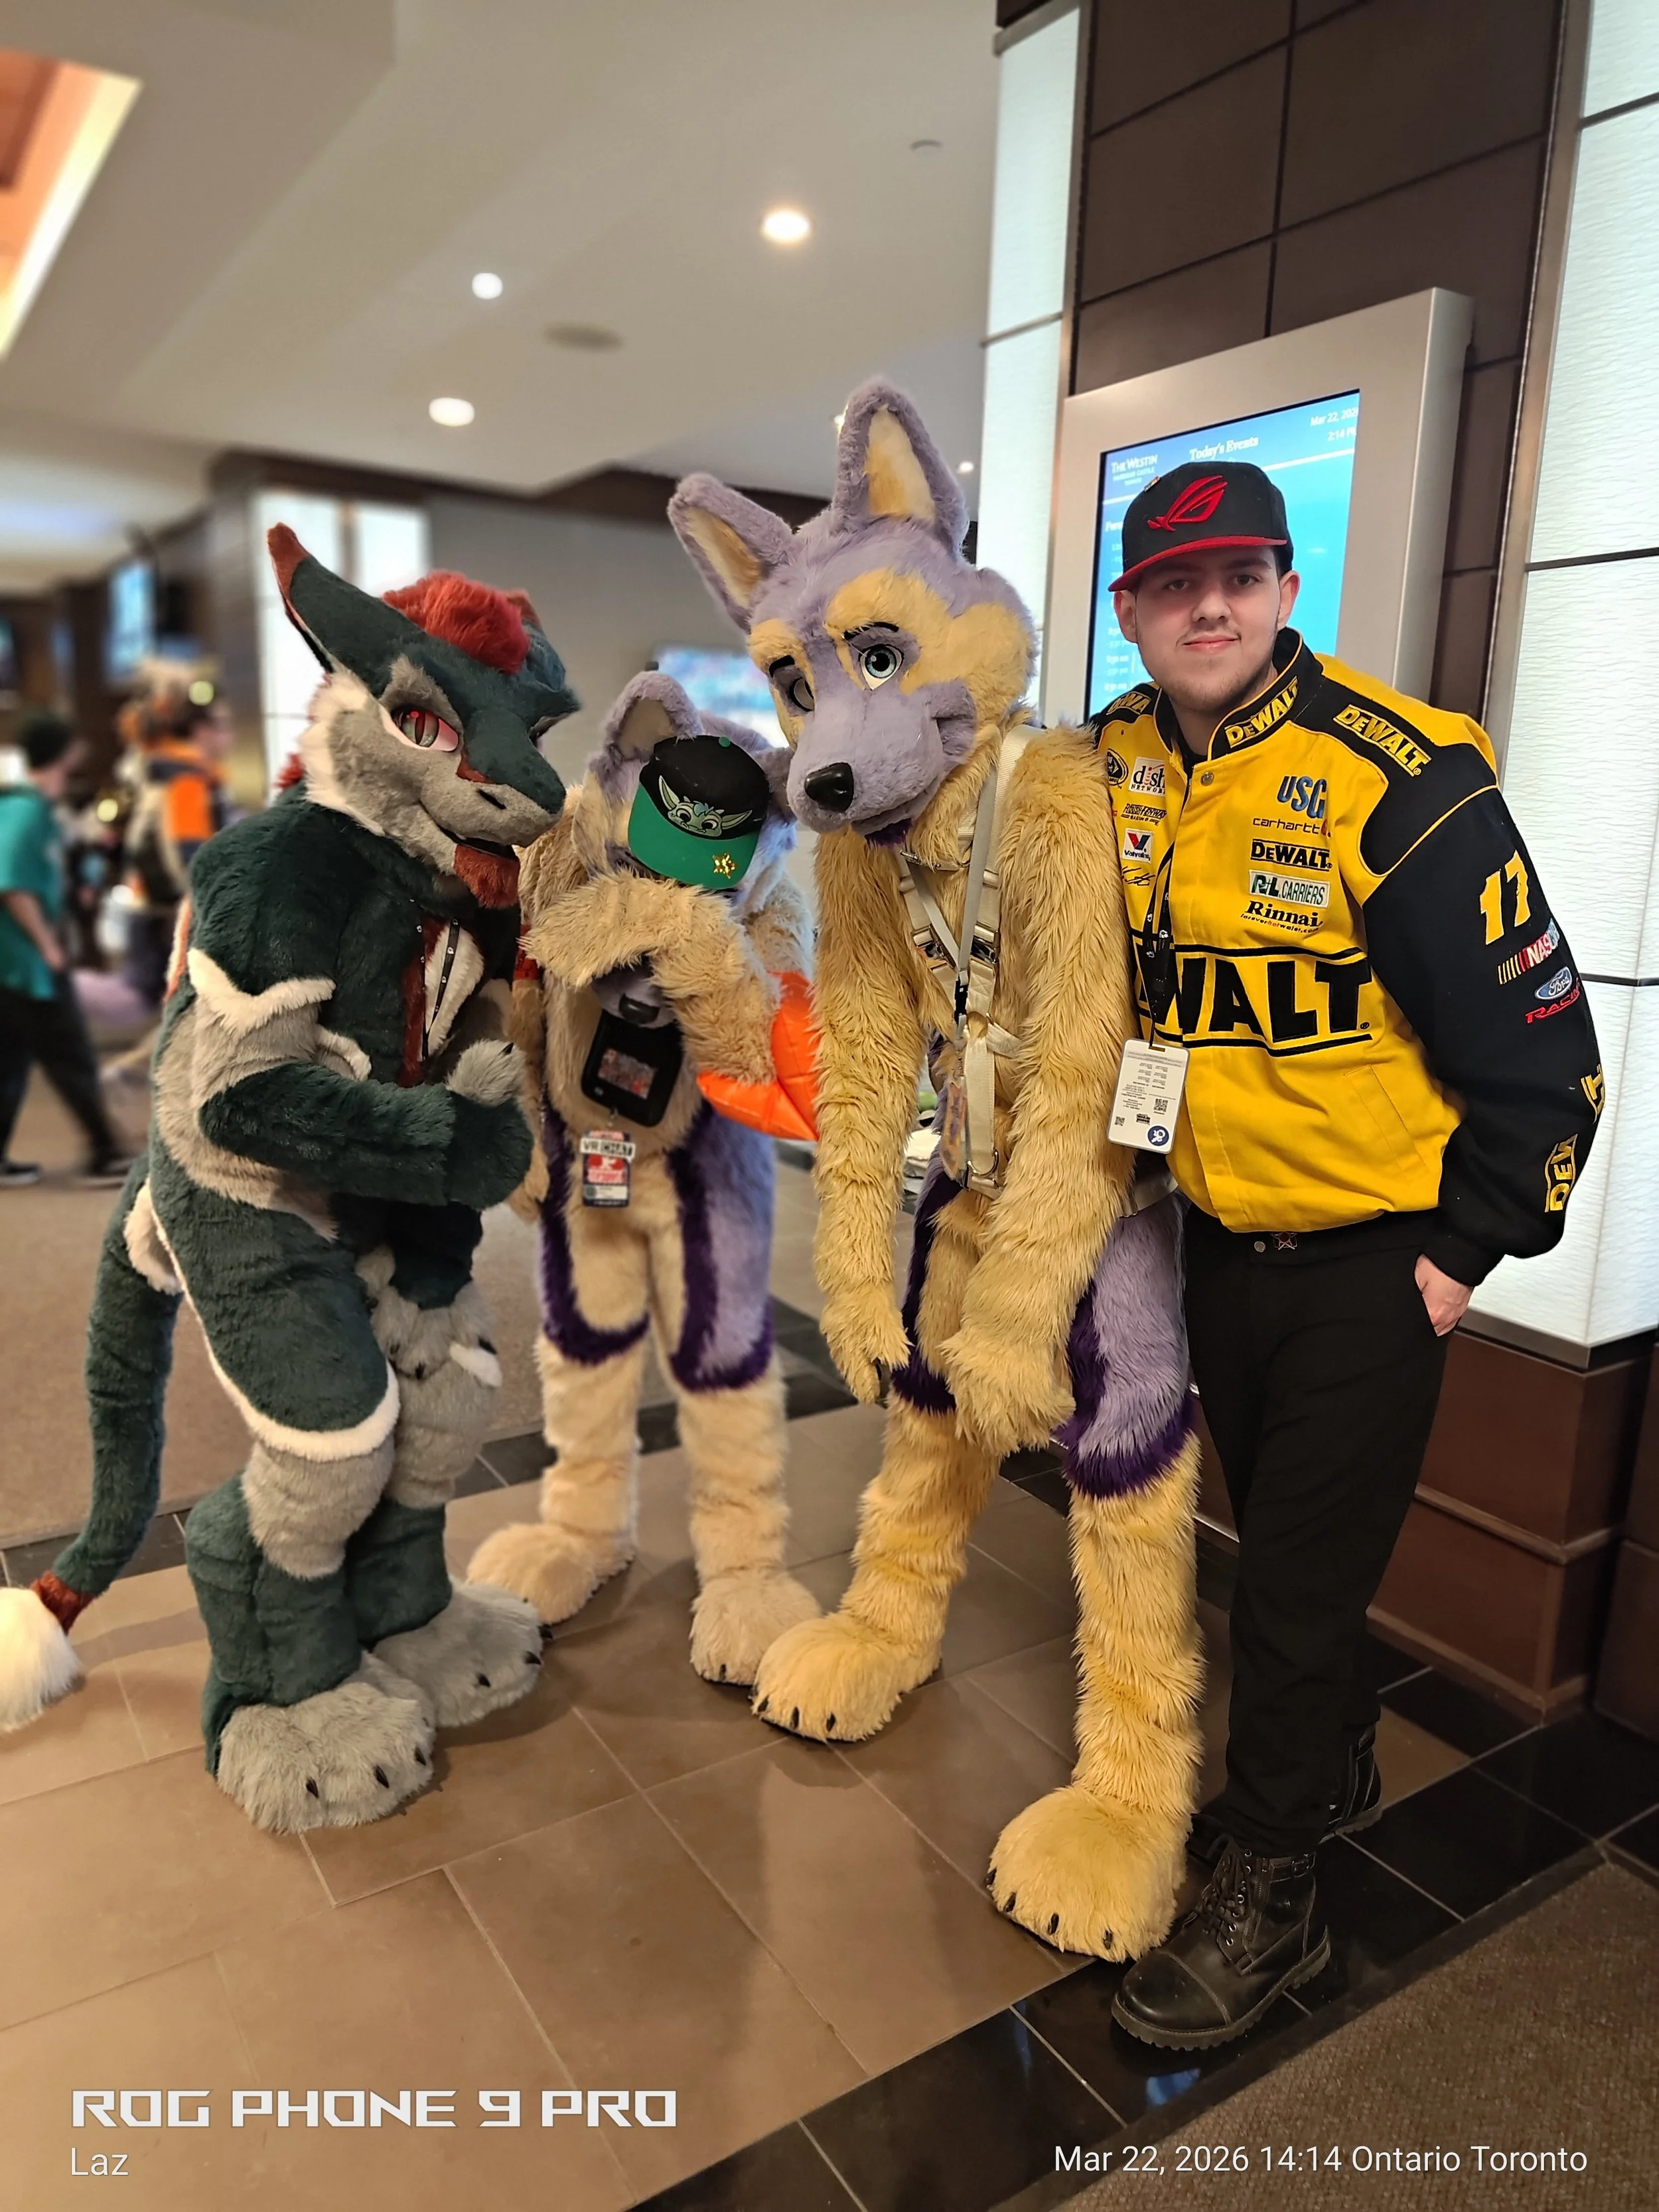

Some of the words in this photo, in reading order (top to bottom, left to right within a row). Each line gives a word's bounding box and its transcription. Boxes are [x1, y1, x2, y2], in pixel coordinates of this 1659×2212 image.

[1127, 454, 1158, 470] WESTIN
[1189, 443, 1225, 461] Today's
[1226, 436, 1259, 453] Events
[1336, 705, 1430, 773] DEWALT
[1277, 775, 1327, 819] USG
[1252, 818, 1321, 835] carhartt
[1250, 840, 1330, 869] DEWALT
[1281, 879, 1325, 905] CARRIERS
[1479, 849, 1531, 946] 17
[1244, 900, 1322, 927] Rinnai
